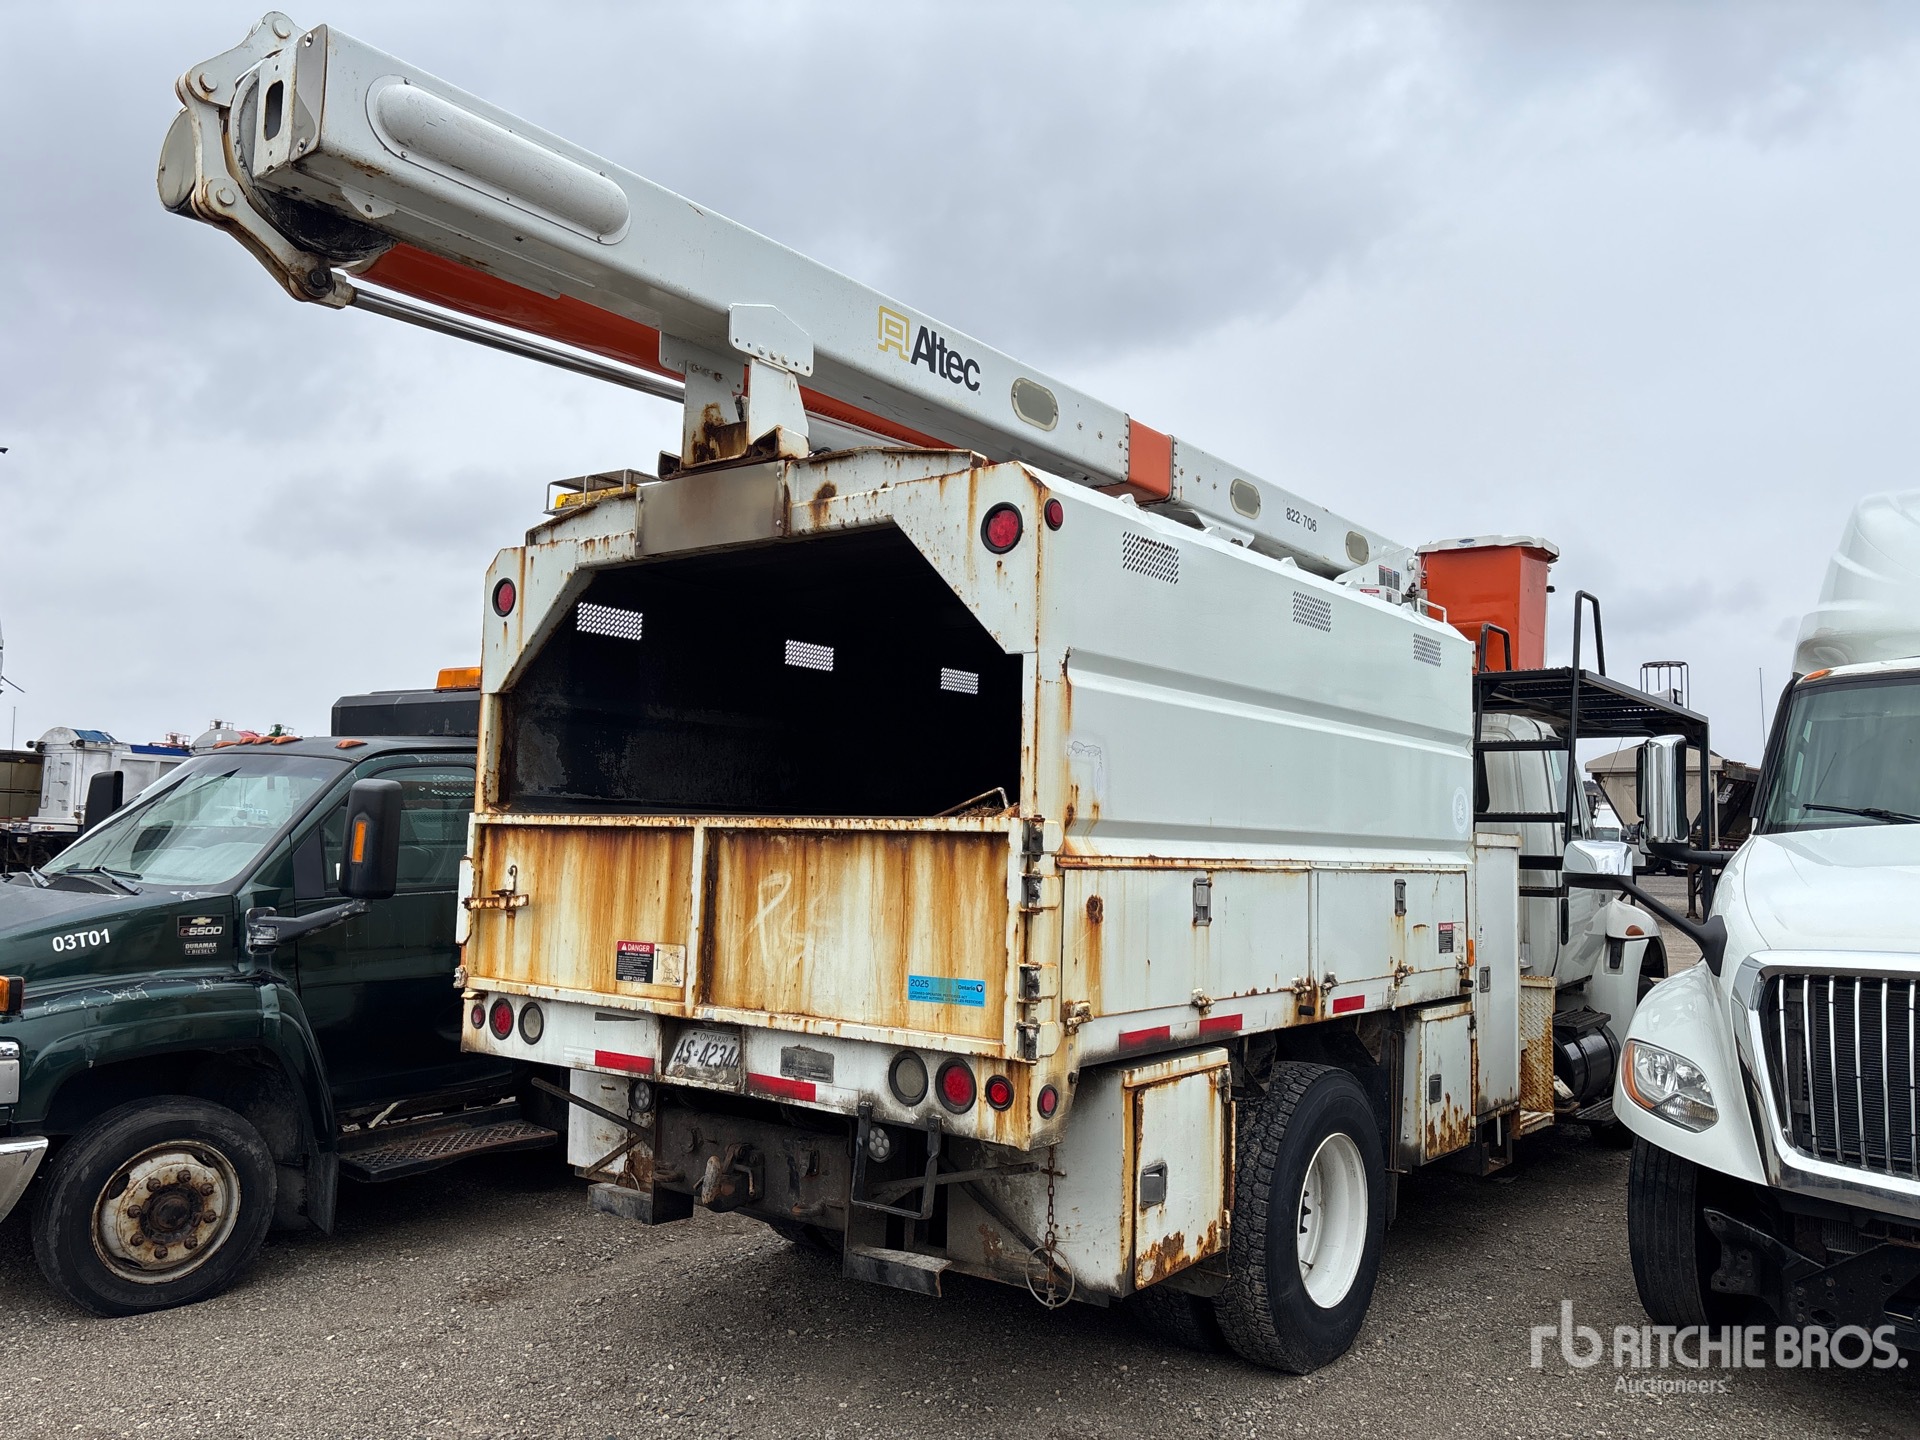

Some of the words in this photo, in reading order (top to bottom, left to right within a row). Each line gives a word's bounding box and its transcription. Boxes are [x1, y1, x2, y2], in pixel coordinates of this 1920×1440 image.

[910, 325, 980, 391] Altec
[179, 926, 223, 936] C5500
[52, 928, 111, 952] 03T01
[627, 944, 650, 952] DANGER
[910, 979, 929, 988] 2025
[700, 1032, 728, 1043] ONTARIO
